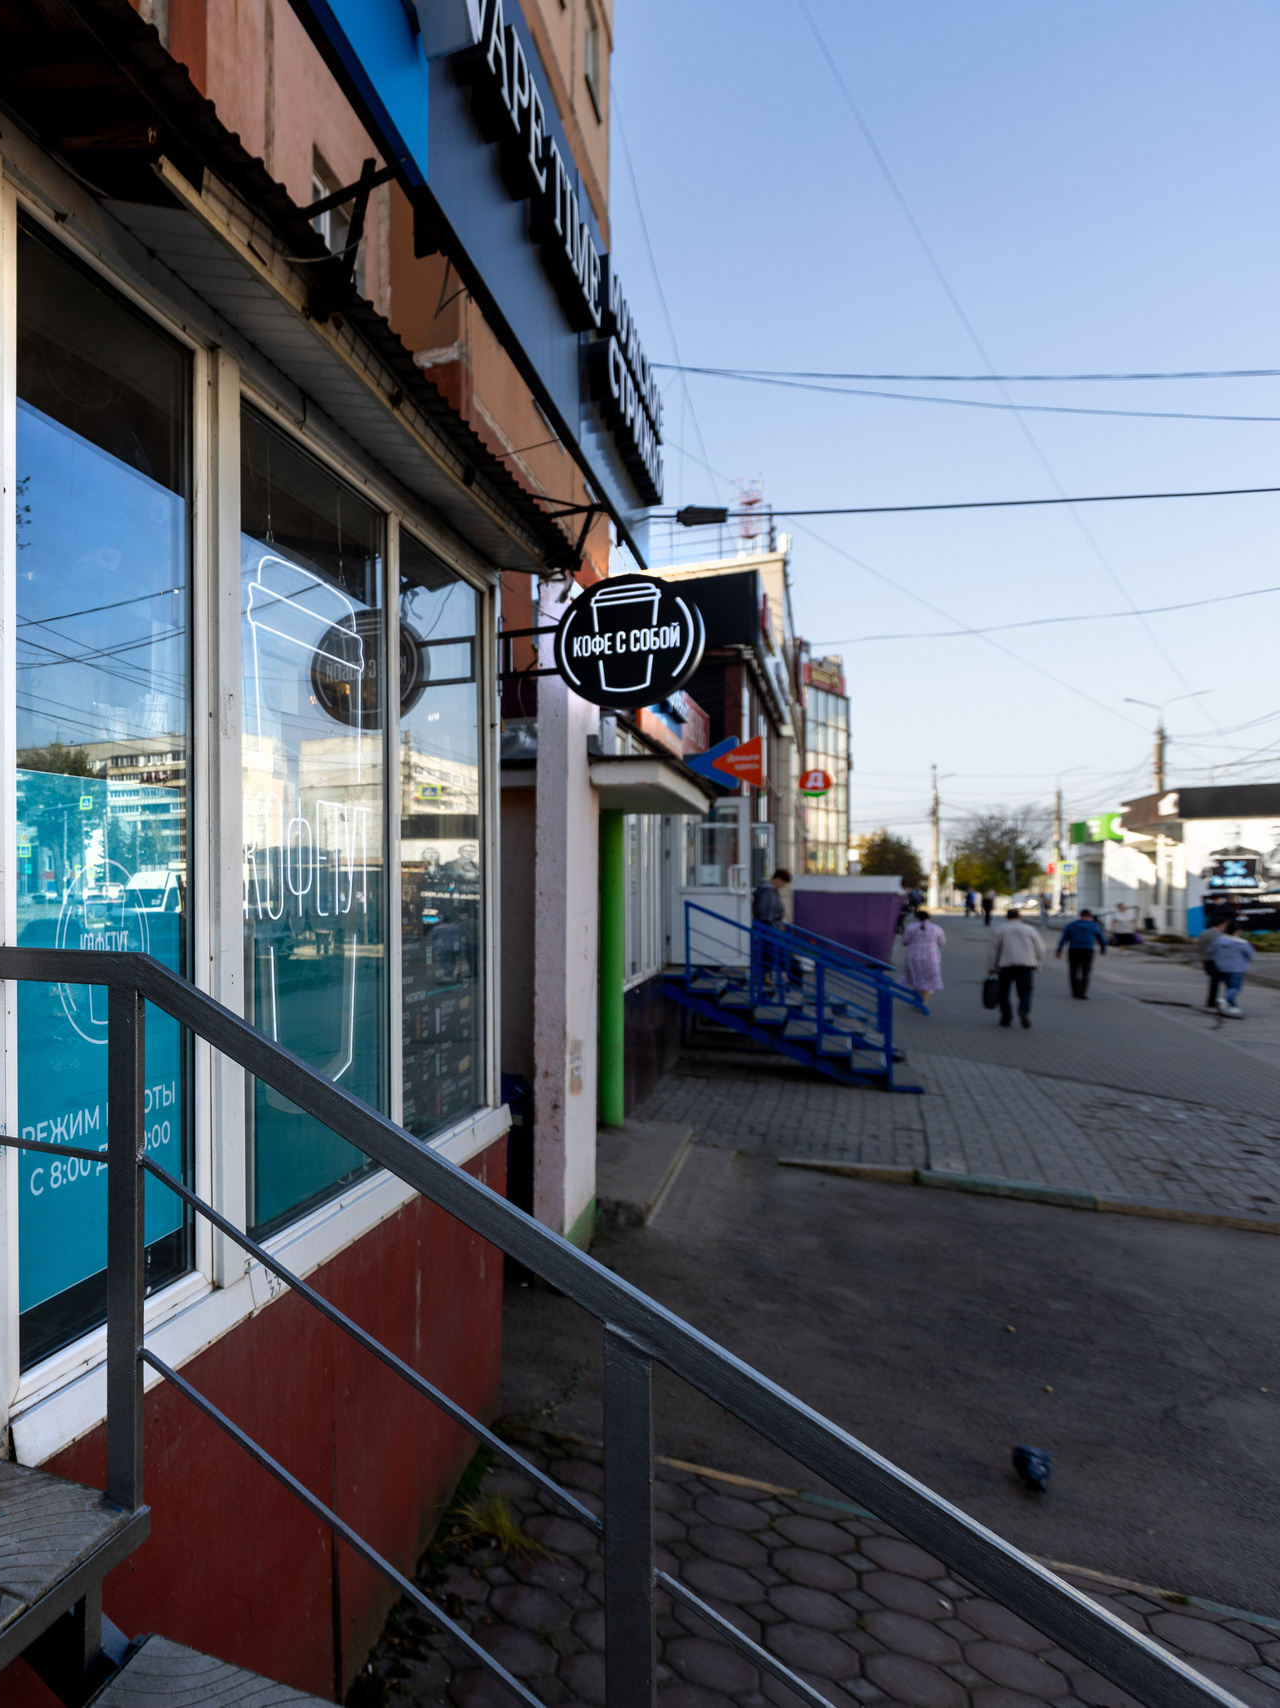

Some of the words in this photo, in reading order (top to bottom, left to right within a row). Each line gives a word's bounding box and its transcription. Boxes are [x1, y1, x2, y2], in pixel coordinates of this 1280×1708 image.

[549, 145, 603, 328] TIME
[609, 262, 664, 444] МУЖСКИЕ
[608, 335, 664, 498] СТРИЖКИ
[573, 633, 613, 658] КОФЕ
[616, 631, 626, 654] С
[630, 622, 681, 652] СОБОЙ
[806, 771, 824, 789] Д
[22, 1105, 100, 1156] РЕЖИМ
[30, 1167, 45, 1196] С
[50, 1157, 92, 1189] 8:00
